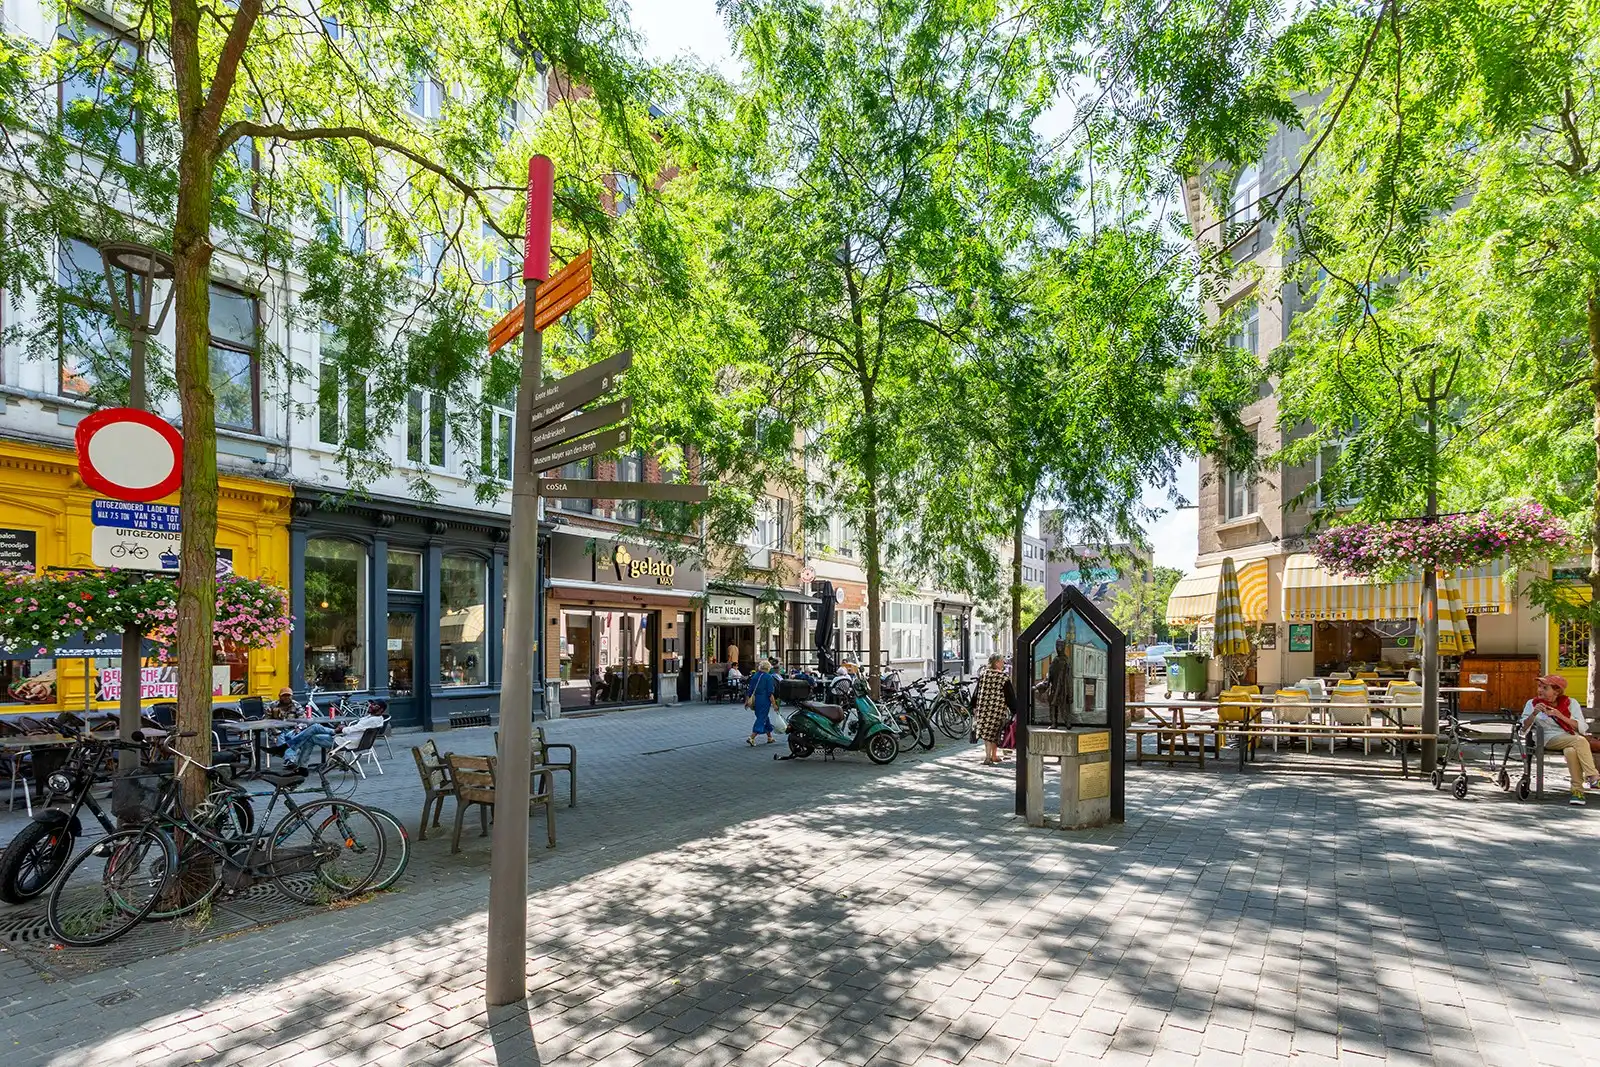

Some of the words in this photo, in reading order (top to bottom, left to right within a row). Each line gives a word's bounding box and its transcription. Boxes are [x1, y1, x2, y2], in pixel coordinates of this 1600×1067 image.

[535, 392, 546, 401] Grote
[546, 386, 560, 396] Markt
[533, 427, 566, 443] Sint-Andrieskerk
[533, 456, 551, 465] Museum
[551, 451, 565, 461] Mayer
[573, 446, 582, 454] den
[582, 441, 597, 451] Bergh
[95, 500, 144, 511] UITGEZONDERD
[147, 504, 167, 514] LADEN
[170, 507, 180, 515] EN
[120, 512, 130, 520] TON
[134, 512, 148, 520] VAN
[151, 513, 156, 521] 5
[166, 514, 179, 522] TOT
[134, 520, 148, 528] VAN
[151, 521, 158, 529] 19
[168, 522, 180, 531] TOT
[116, 528, 181, 541] UITGEZONDE
[631, 557, 675, 579] gelato
[660, 577, 674, 586] MAX
[709, 605, 723, 614] HET
[725, 606, 751, 616] NEUSJE
